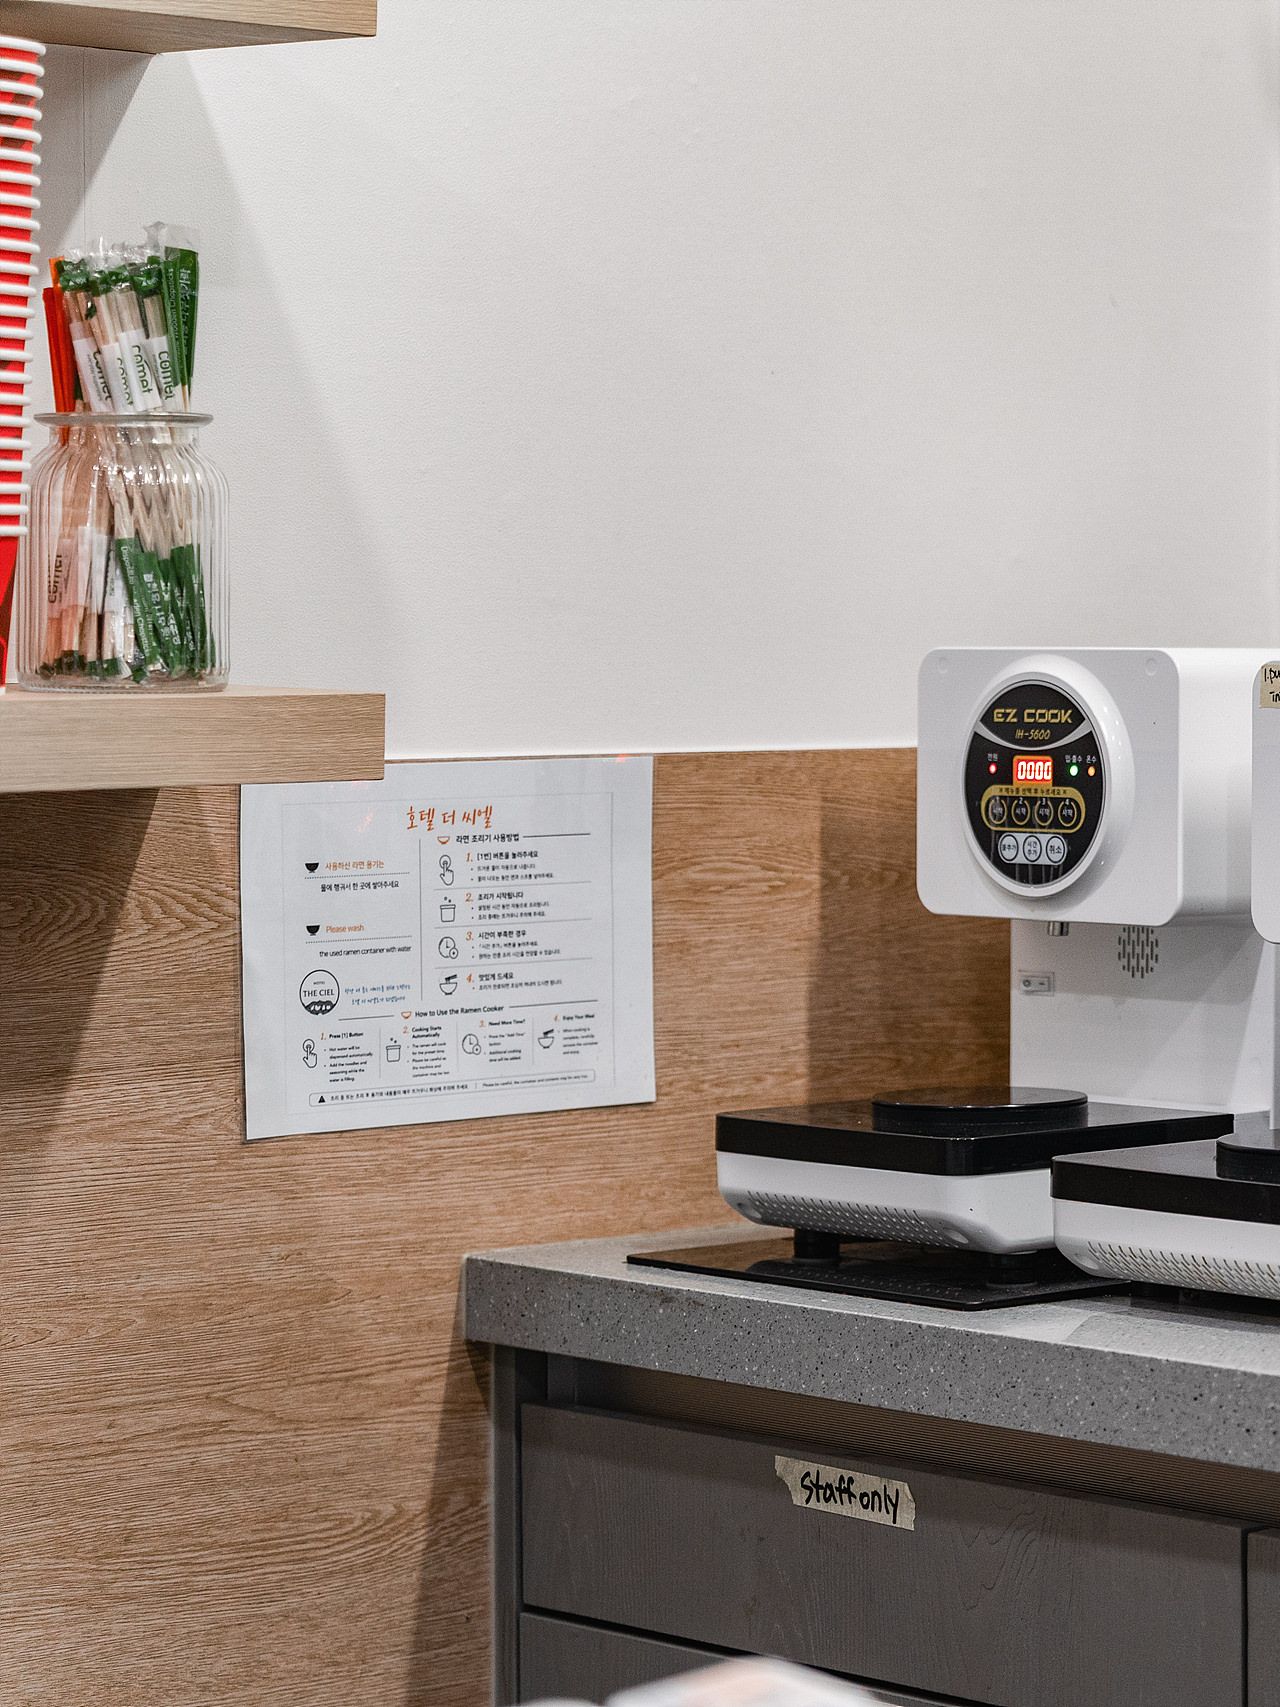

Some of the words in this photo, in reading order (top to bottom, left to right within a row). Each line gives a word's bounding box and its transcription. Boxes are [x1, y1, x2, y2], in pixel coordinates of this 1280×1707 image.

[993, 708, 1017, 723] EZ
[1023, 708, 1073, 724] COOK
[1015, 729, 1051, 740] IH-5600
[1017, 761, 1052, 780] 0000
[406, 805, 435, 831] 호텔
[441, 810, 456, 825] 더
[462, 805, 493, 829] 씨엘
[456, 836, 470, 844] 라면
[471, 835, 491, 844] 조리기
[493, 833, 520, 843] 사용방법
[352, 861, 365, 870] 라면
[352, 882, 359, 891] 한
[325, 925, 347, 934] Please
[348, 924, 365, 933] wash
[330, 950, 342, 958] used
[361, 947, 385, 956] container
[398, 945, 412, 953] water
[303, 989, 318, 998] THE
[319, 988, 335, 997] CIEL
[449, 1007, 459, 1015] the
[460, 1006, 482, 1014] Ramen
[483, 1005, 504, 1013] Cooker
